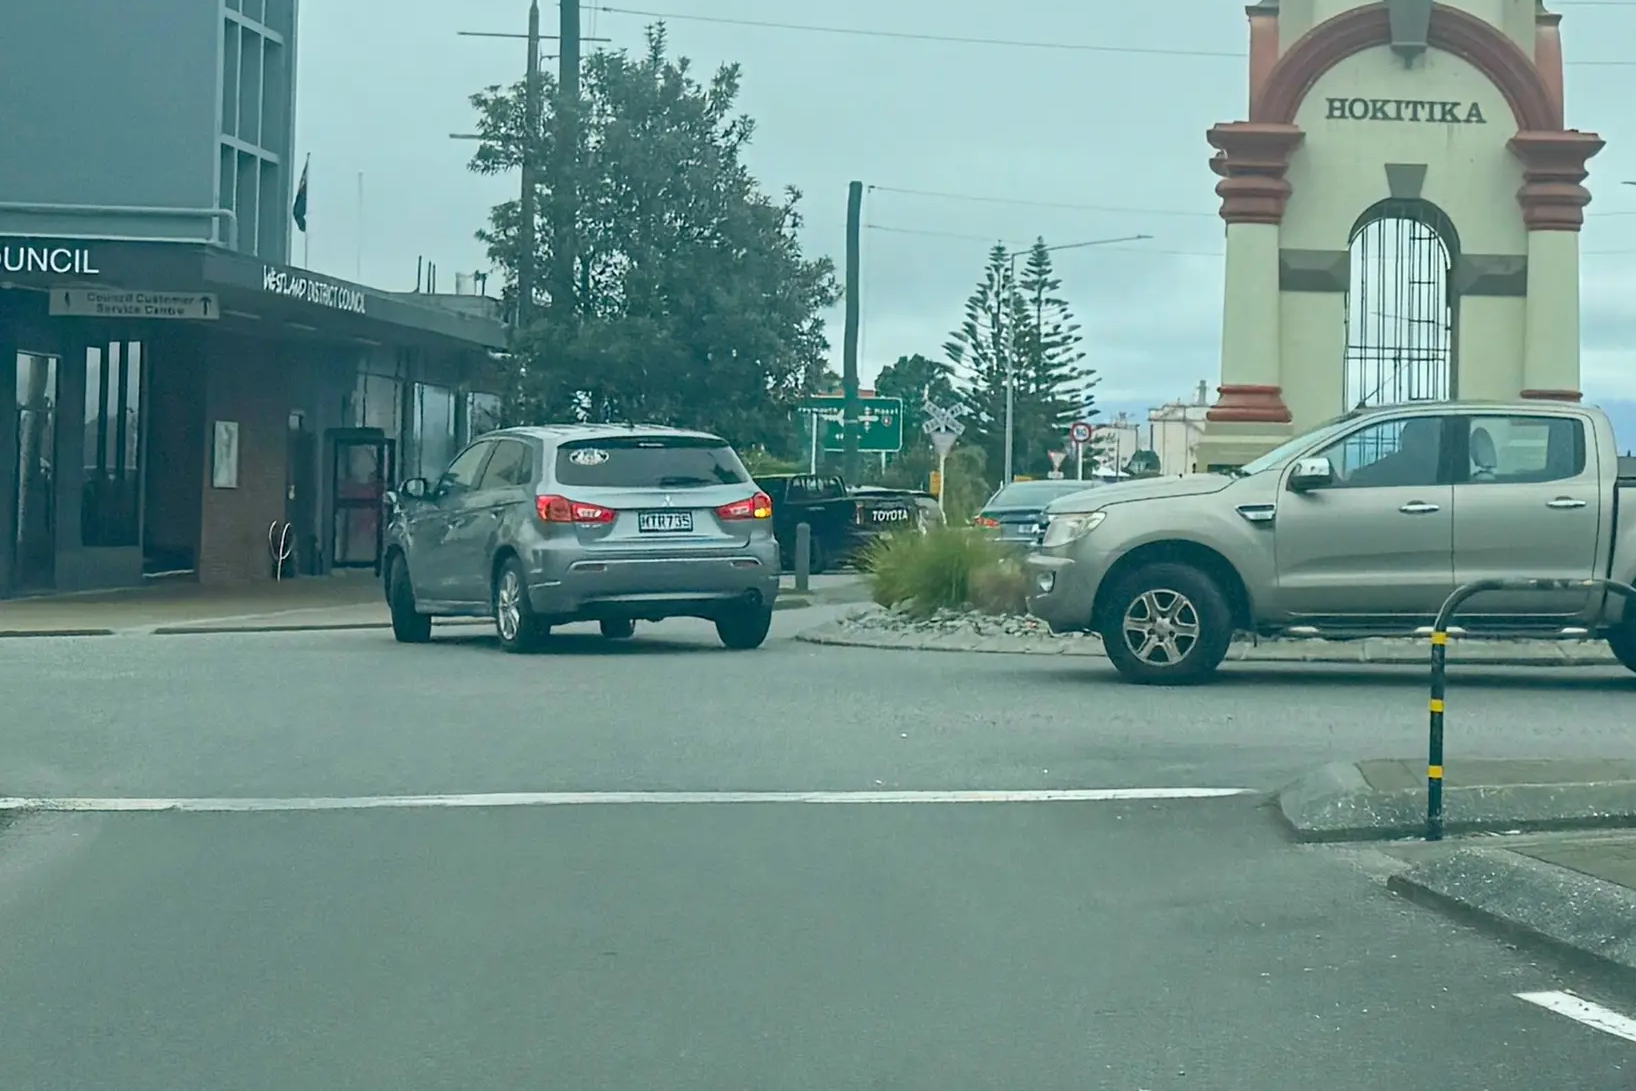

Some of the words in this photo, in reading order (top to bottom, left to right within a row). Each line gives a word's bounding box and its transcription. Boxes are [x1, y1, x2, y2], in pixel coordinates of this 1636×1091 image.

[1325, 97, 1487, 124] HOKITIKA
[0, 246, 100, 274] UNCIL
[872, 509, 909, 522] TOYOTA
